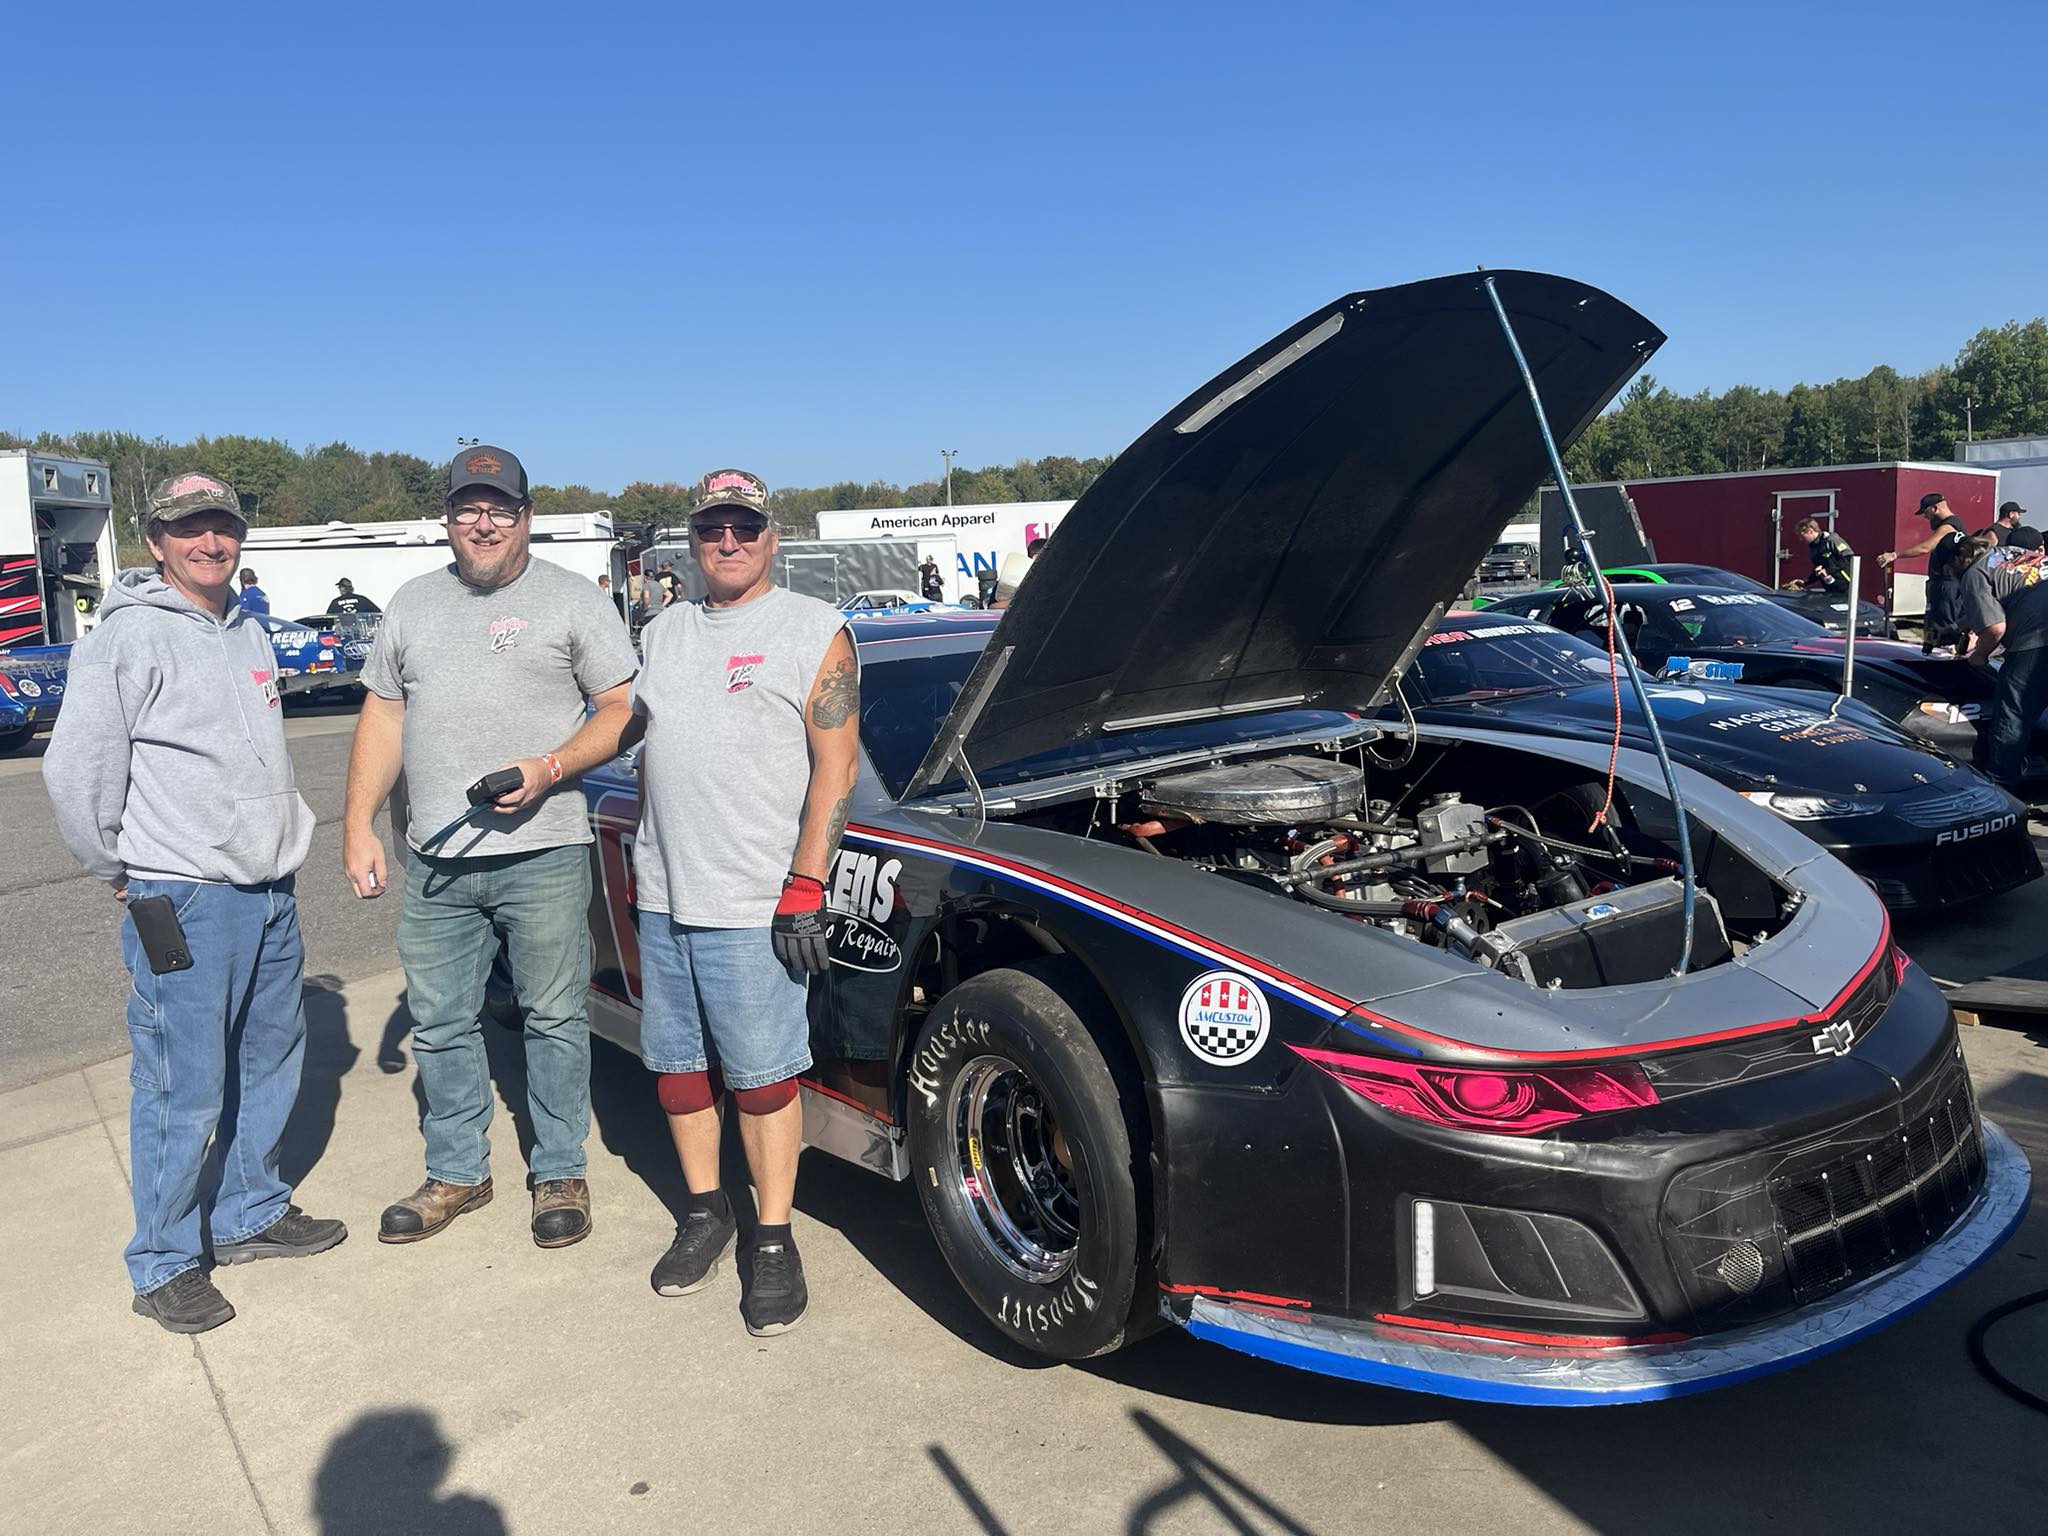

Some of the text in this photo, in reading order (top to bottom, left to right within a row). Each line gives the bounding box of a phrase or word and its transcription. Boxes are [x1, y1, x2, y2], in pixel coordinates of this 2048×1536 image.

[871, 512, 996, 529] American Apparel
[1668, 598, 1697, 613] 12
[272, 630, 319, 644] REPAIR
[1936, 813, 2017, 847] FUSION
[840, 919, 897, 961] Repair
